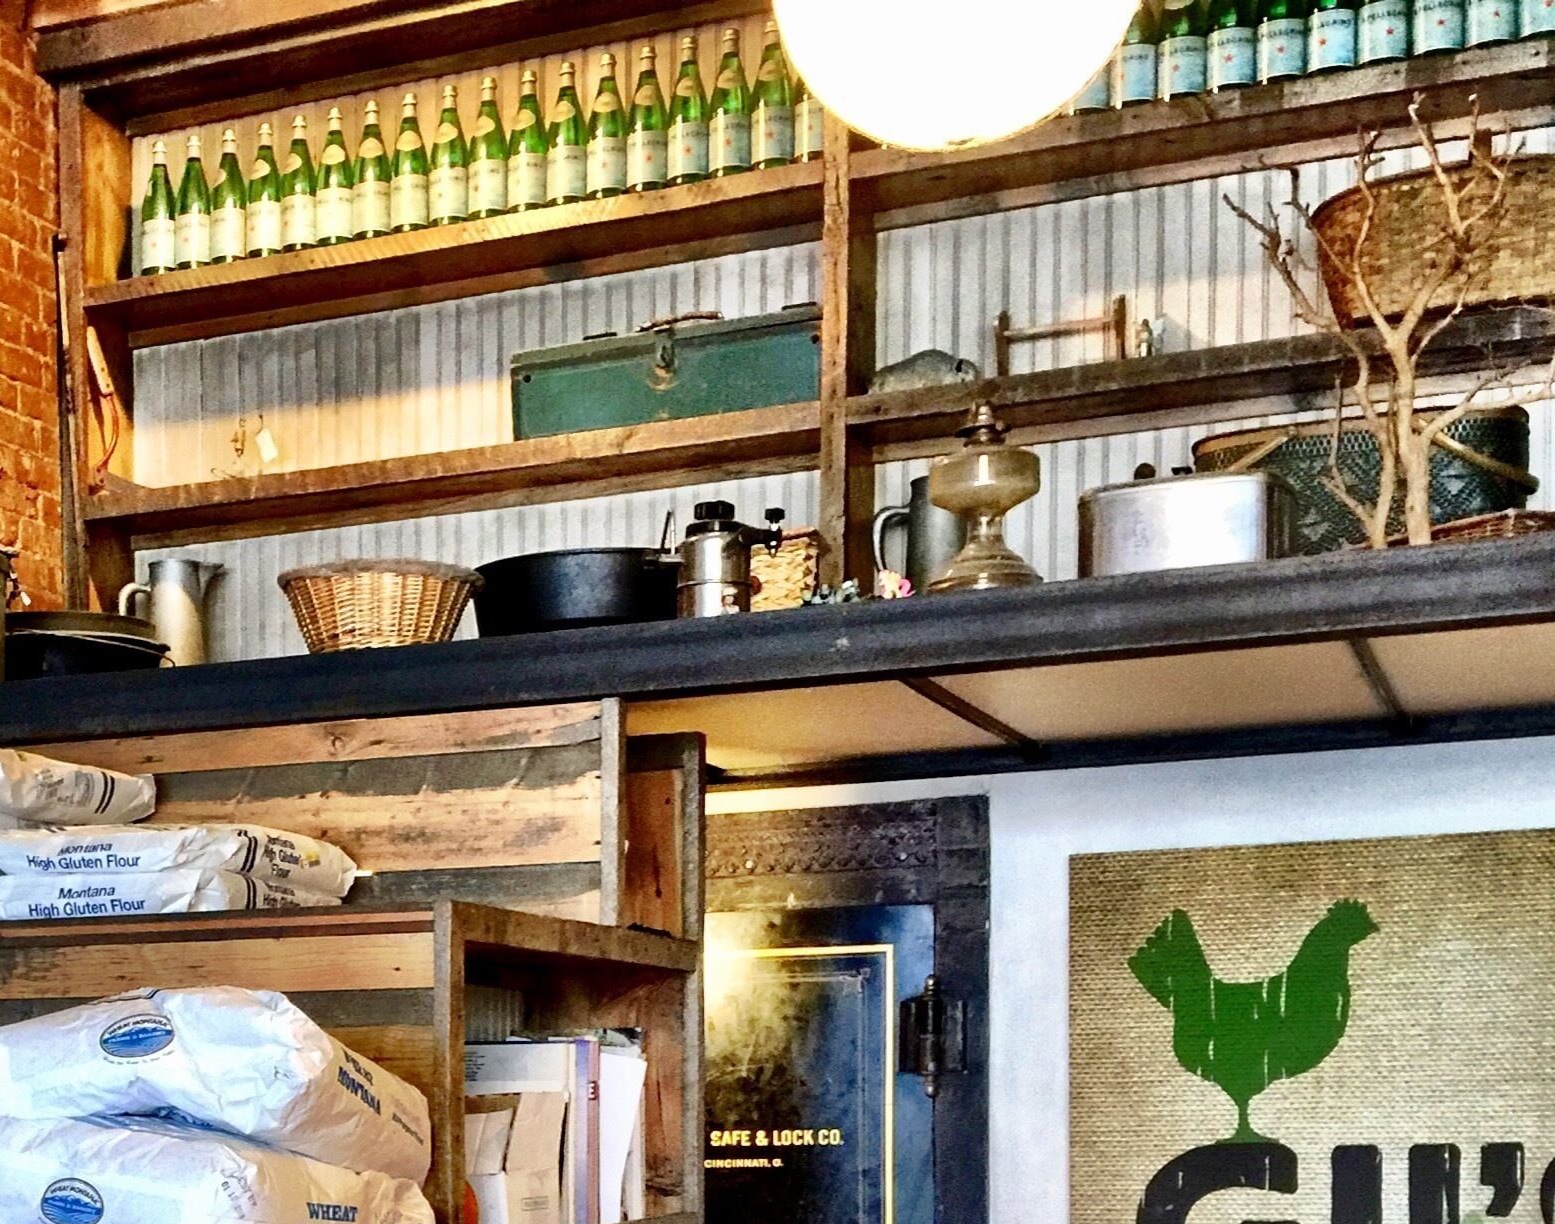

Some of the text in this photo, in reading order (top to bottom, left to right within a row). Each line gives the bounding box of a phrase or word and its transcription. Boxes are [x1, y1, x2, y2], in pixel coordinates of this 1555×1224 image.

[58, 843, 113, 856] Montana
[27, 854, 141, 871] High Gluten Flour
[58, 887, 115, 899] Montana
[29, 900, 146, 918] High Gluten Flour
[710, 1128, 845, 1147] SAFE & LOCK CO.
[306, 1202, 358, 1222] WHEAT
